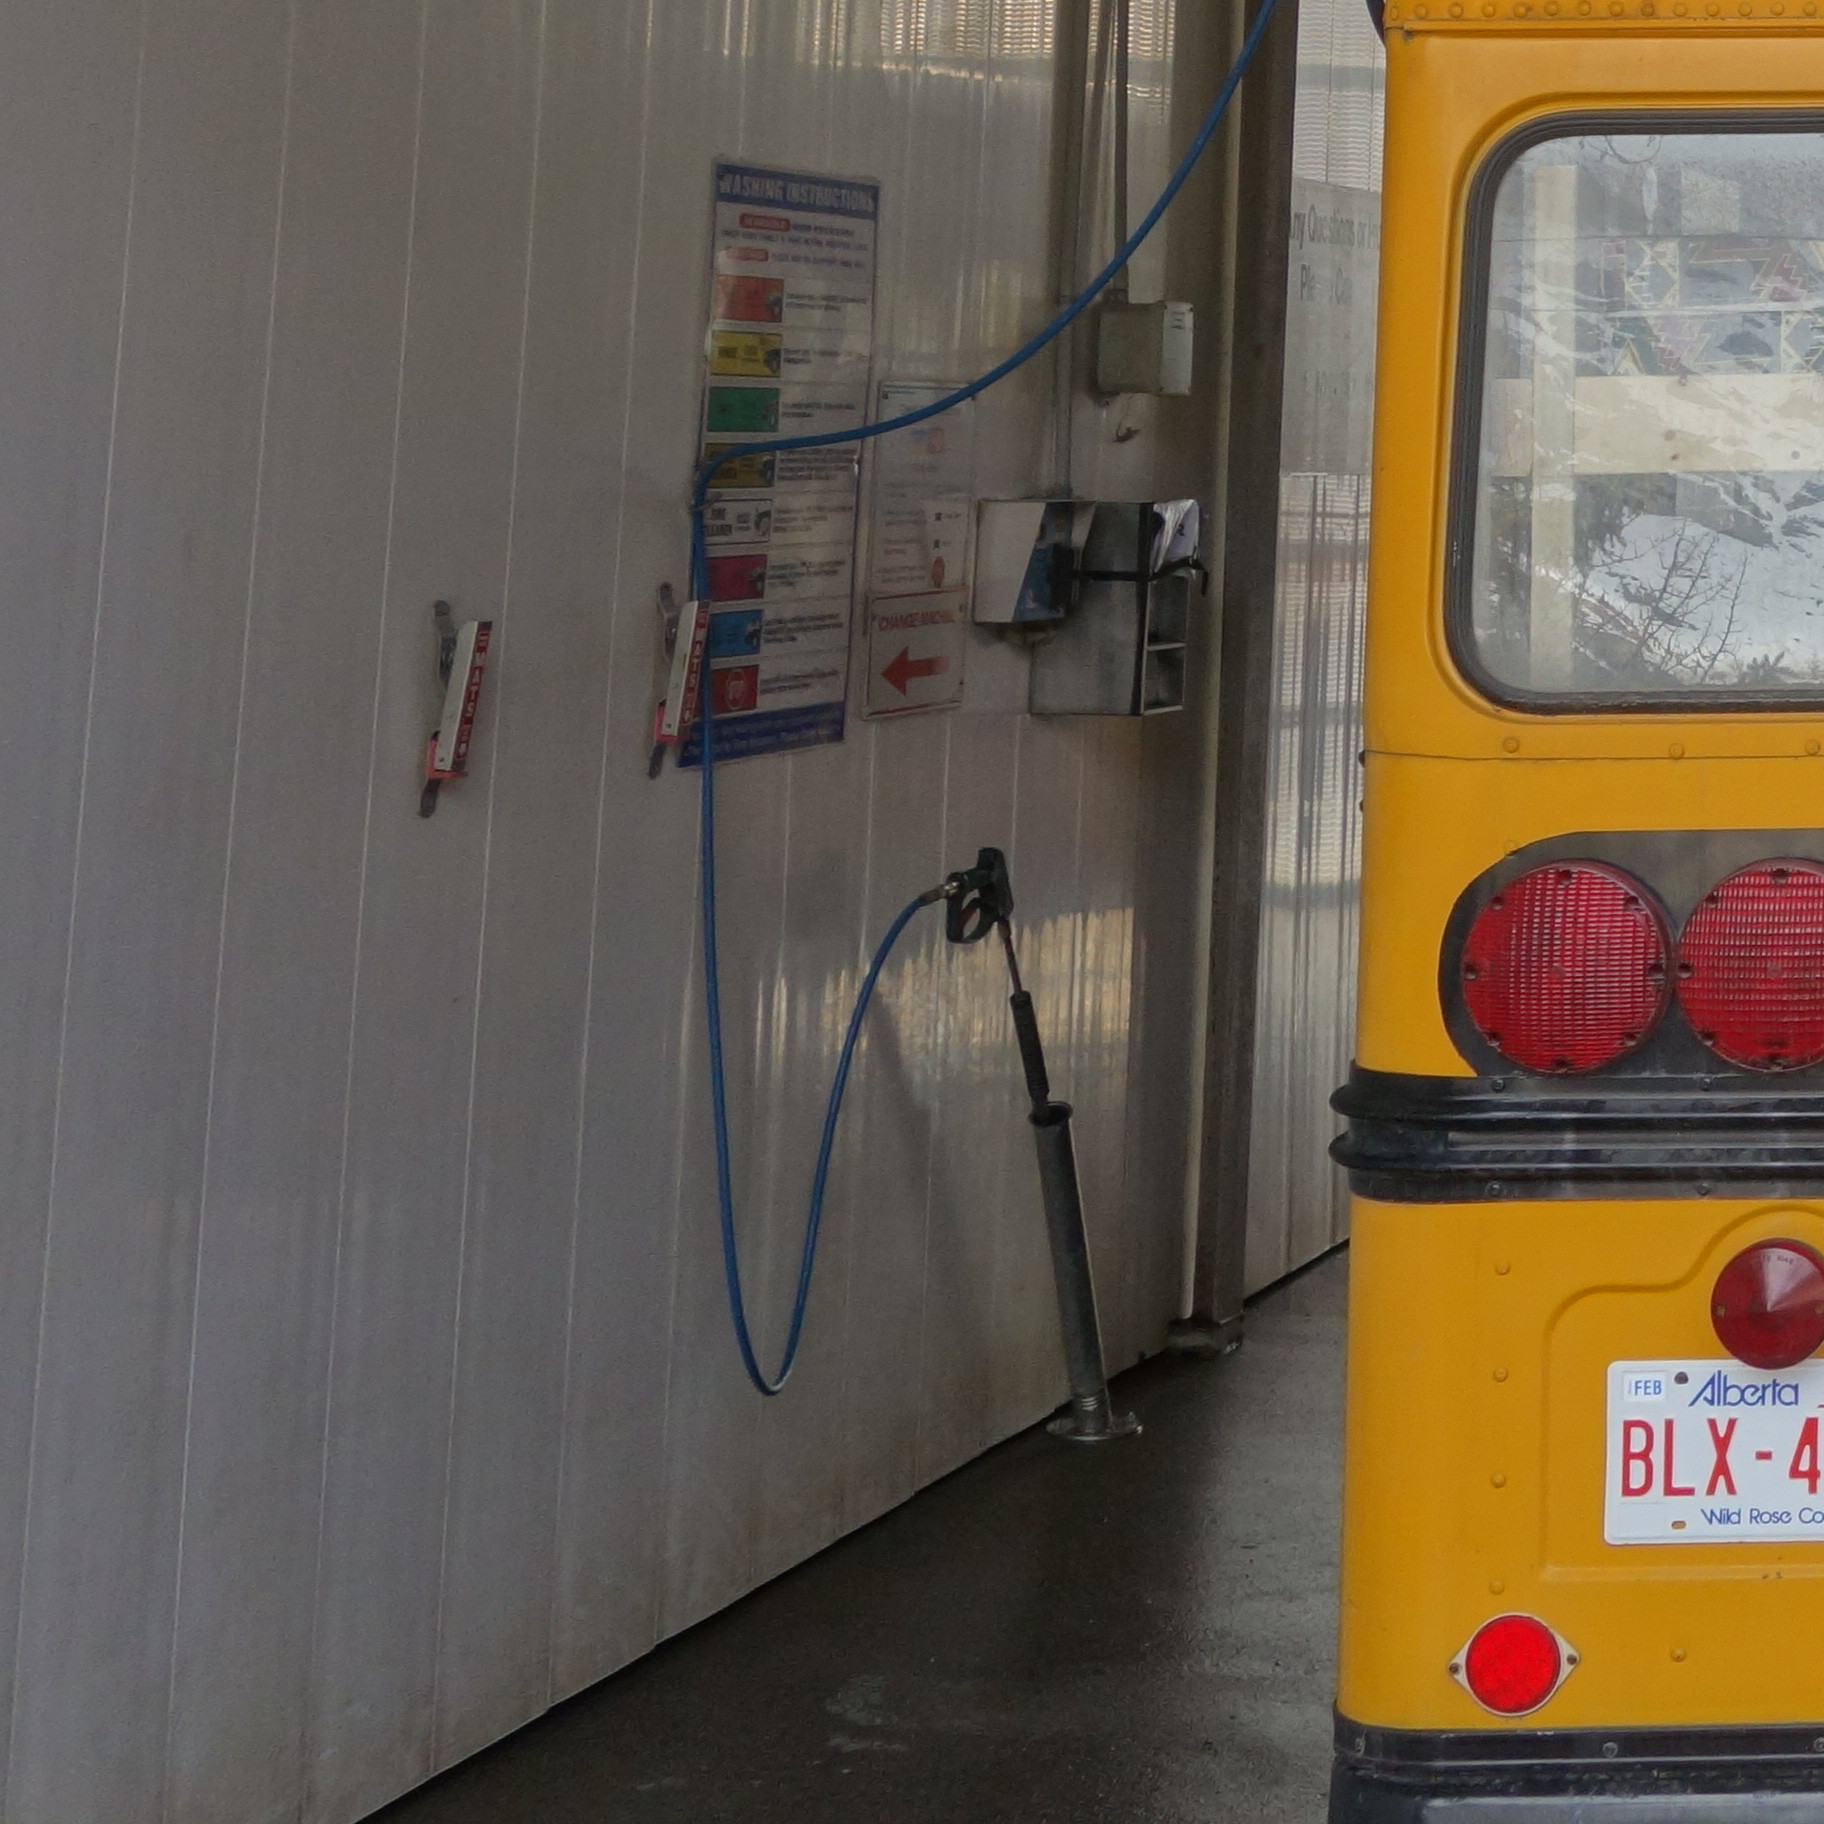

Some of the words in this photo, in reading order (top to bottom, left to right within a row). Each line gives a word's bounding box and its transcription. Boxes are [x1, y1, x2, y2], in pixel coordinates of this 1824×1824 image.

[1634, 1379, 1663, 1396] FEB
[1688, 1370, 1800, 1408] Alberta
[1700, 1507, 1741, 1525] Wild
[1749, 1507, 1793, 1525] Rose
